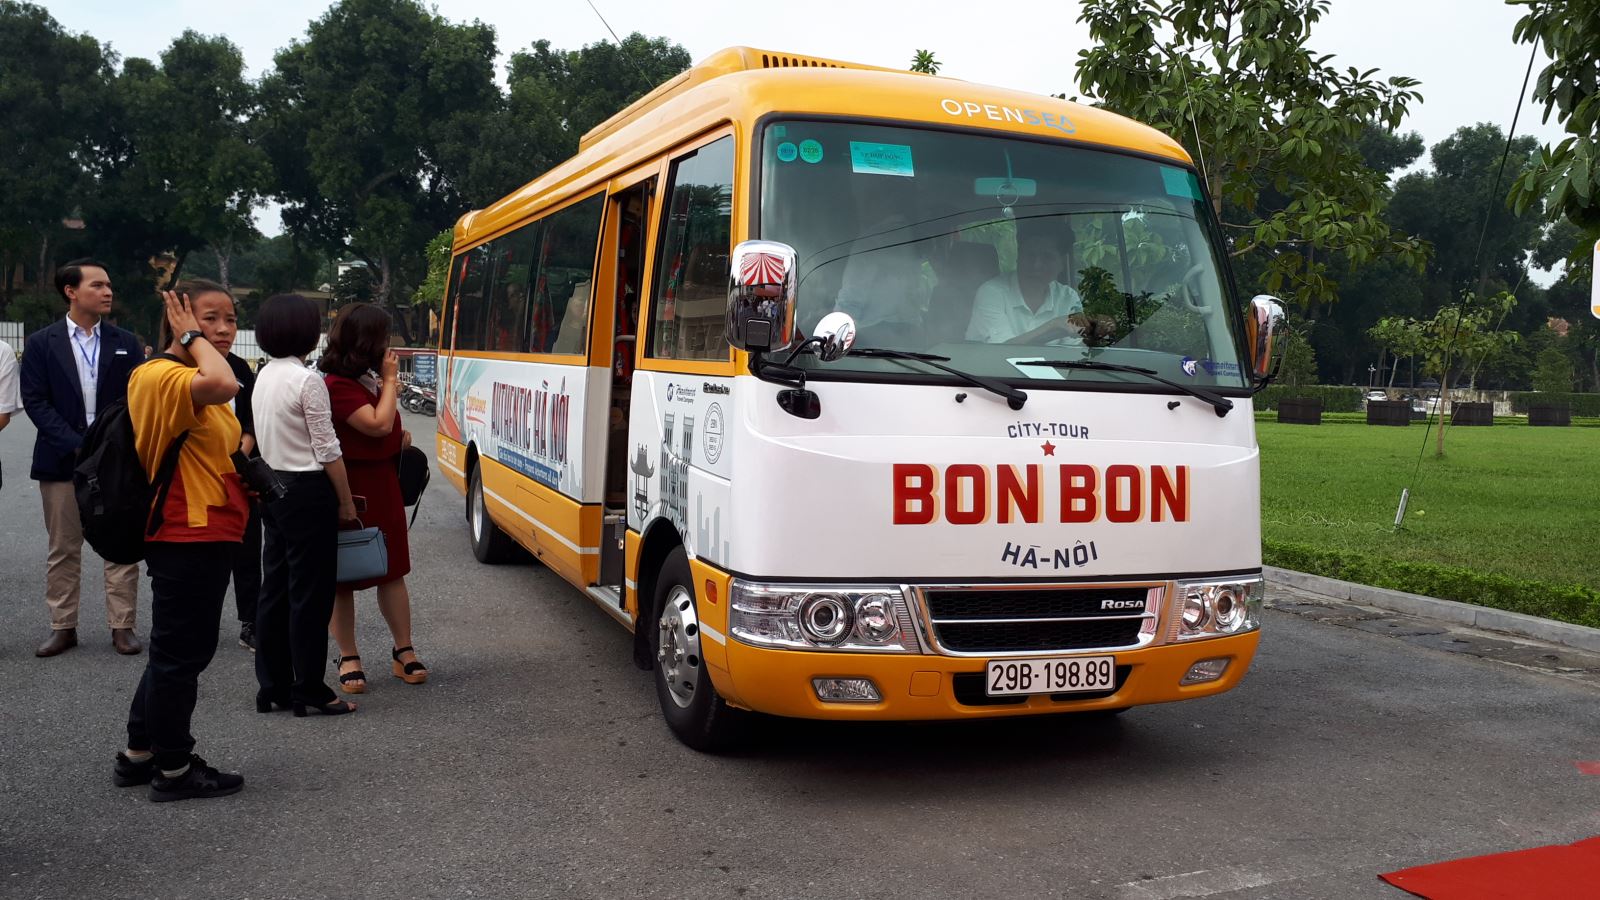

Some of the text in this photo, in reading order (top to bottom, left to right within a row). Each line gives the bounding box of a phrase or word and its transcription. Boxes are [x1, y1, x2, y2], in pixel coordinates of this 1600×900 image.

[941, 98, 1076, 134] OPENSEA
[892, 463, 1190, 525] BON BON
[991, 660, 1111, 692] 29B-198.89
